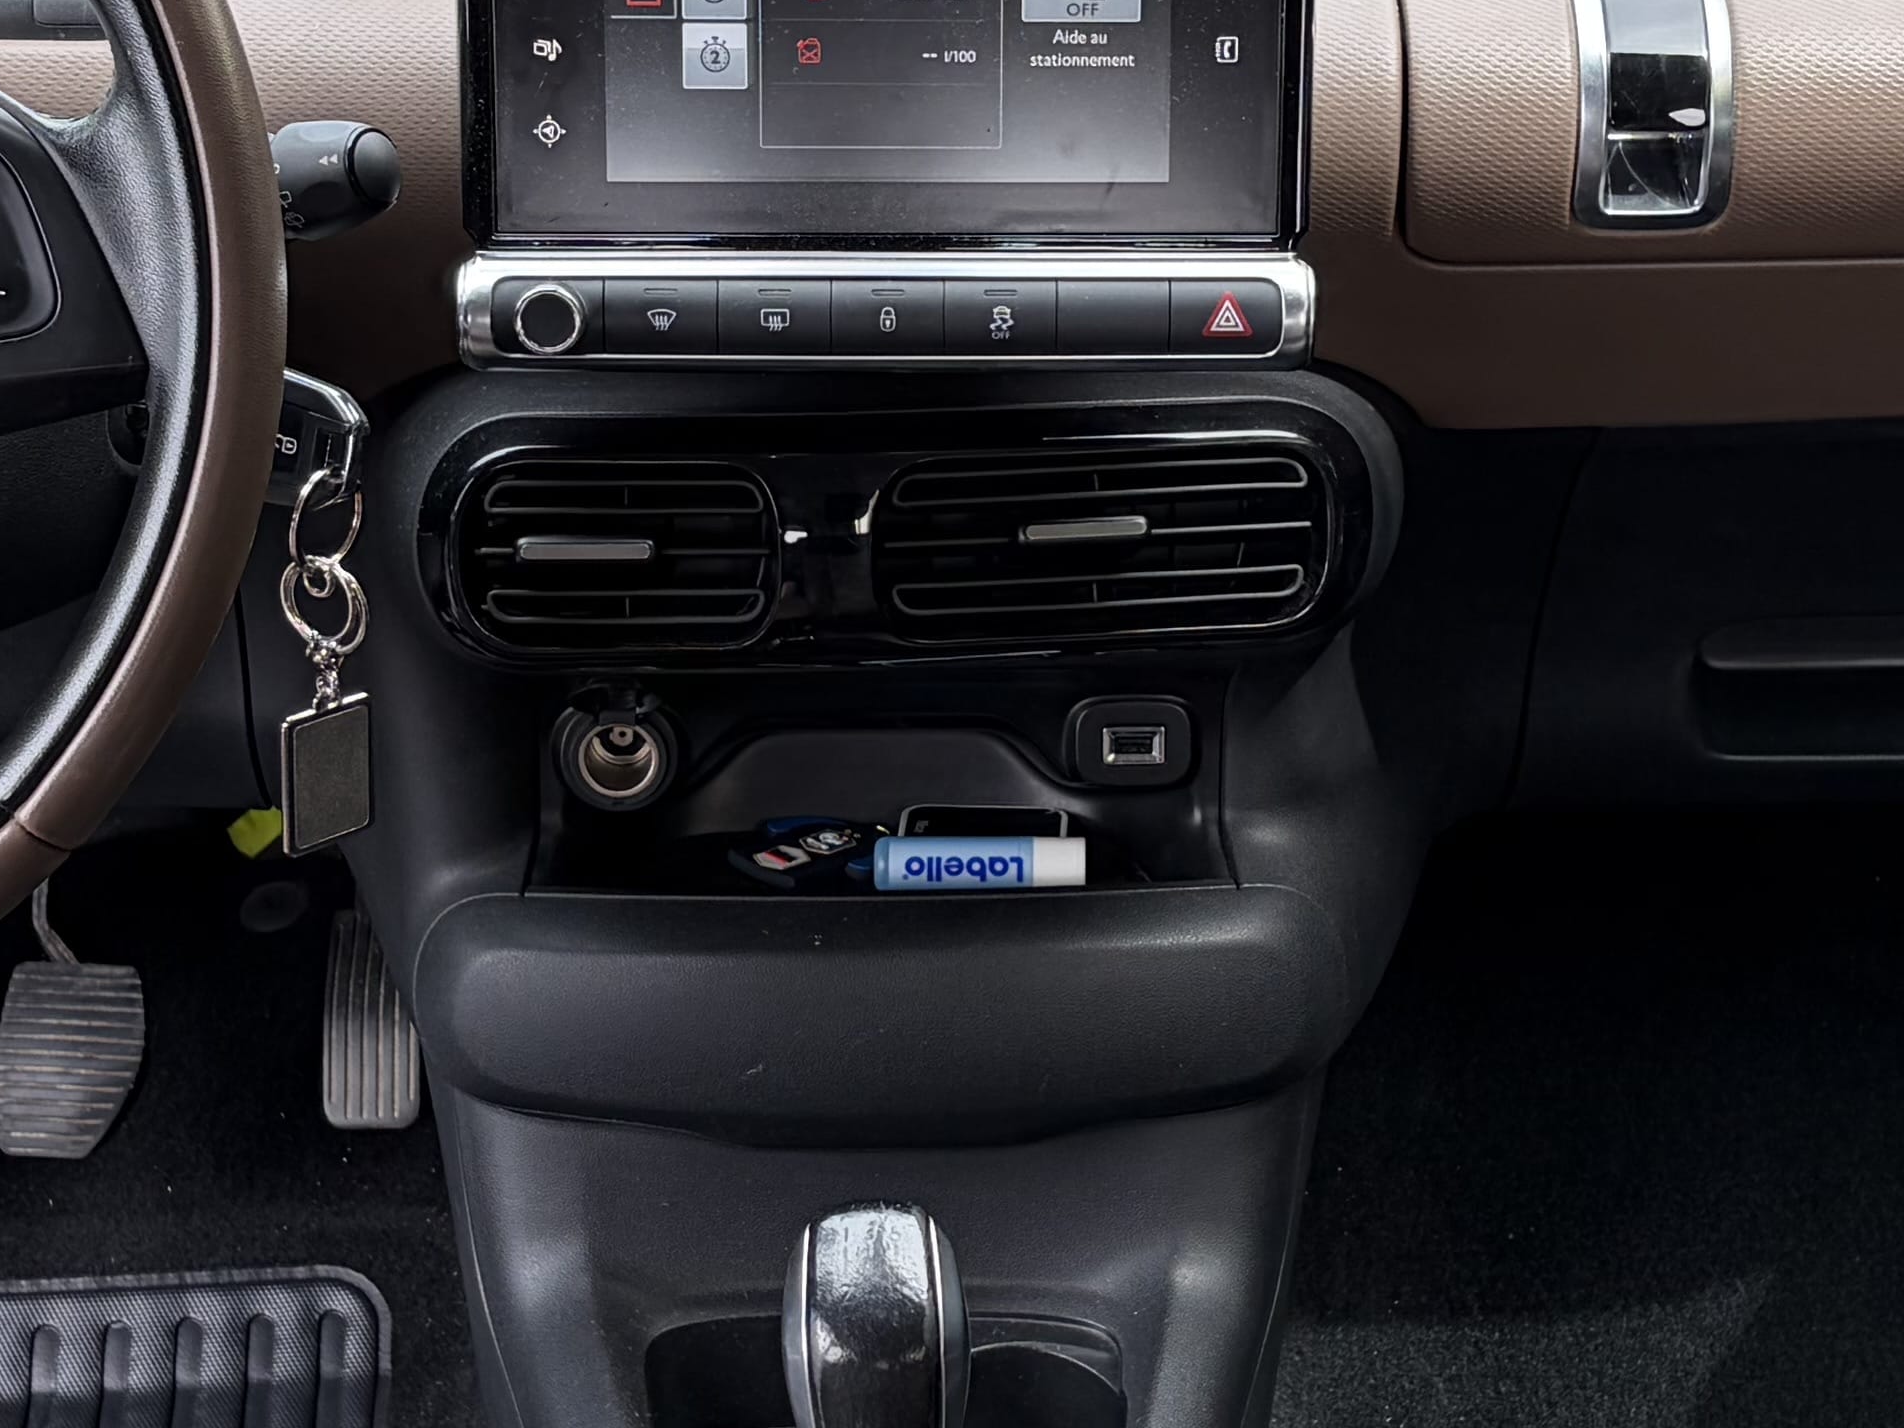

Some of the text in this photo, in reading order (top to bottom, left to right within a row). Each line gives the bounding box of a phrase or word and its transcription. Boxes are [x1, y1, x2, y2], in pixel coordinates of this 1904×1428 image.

[1066, 2, 1101, 17] OFF
[1052, 29, 1108, 45] Aide au
[1029, 53, 1136, 68] stationnement
[904, 855, 1025, 883] Labello
